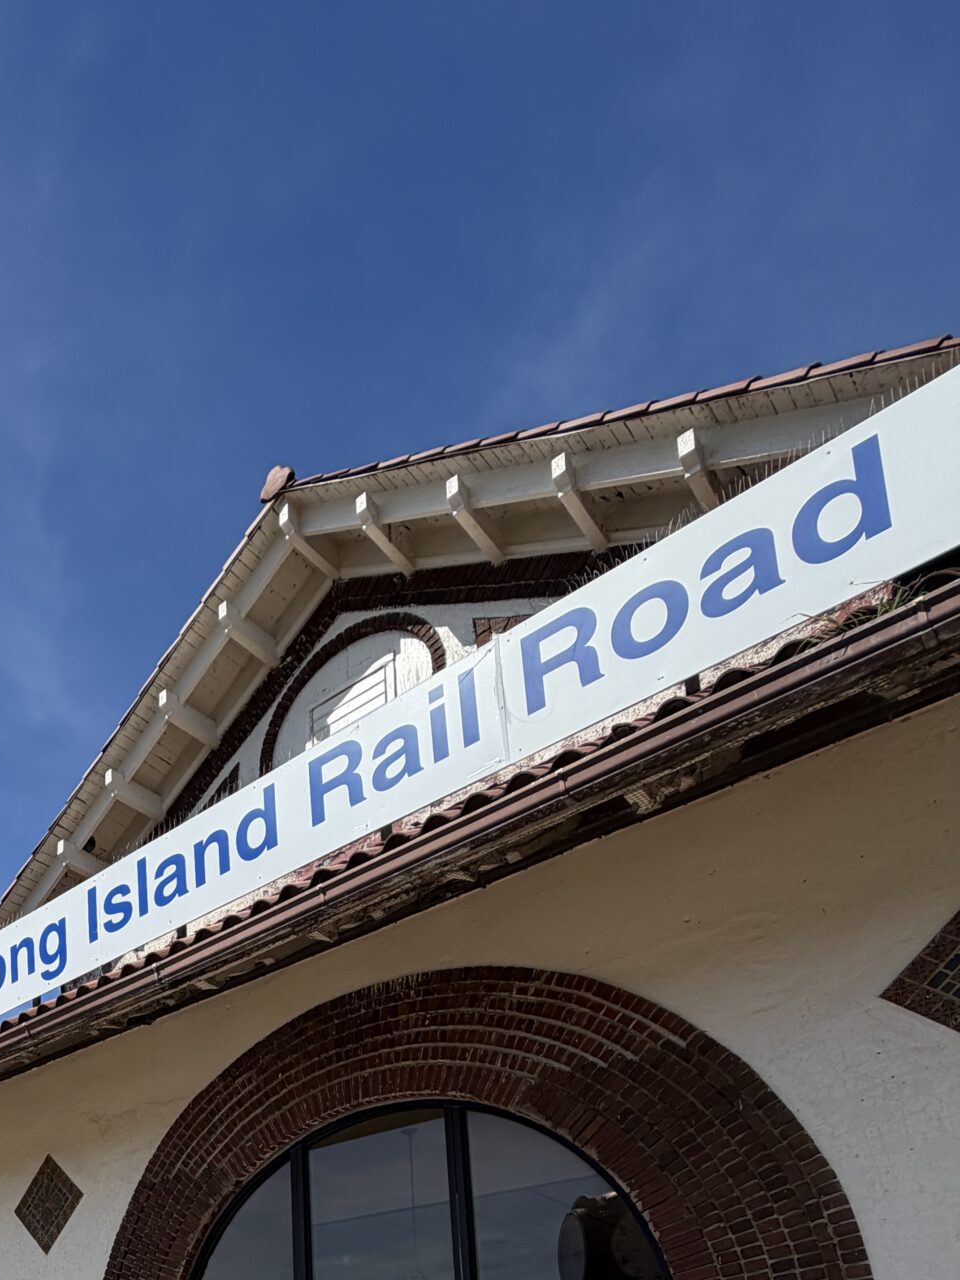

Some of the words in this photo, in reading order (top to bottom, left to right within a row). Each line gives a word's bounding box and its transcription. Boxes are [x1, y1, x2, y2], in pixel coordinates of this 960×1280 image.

[87, 782, 279, 944] Island
[308, 668, 482, 827] Rail
[520, 433, 892, 716] Road
